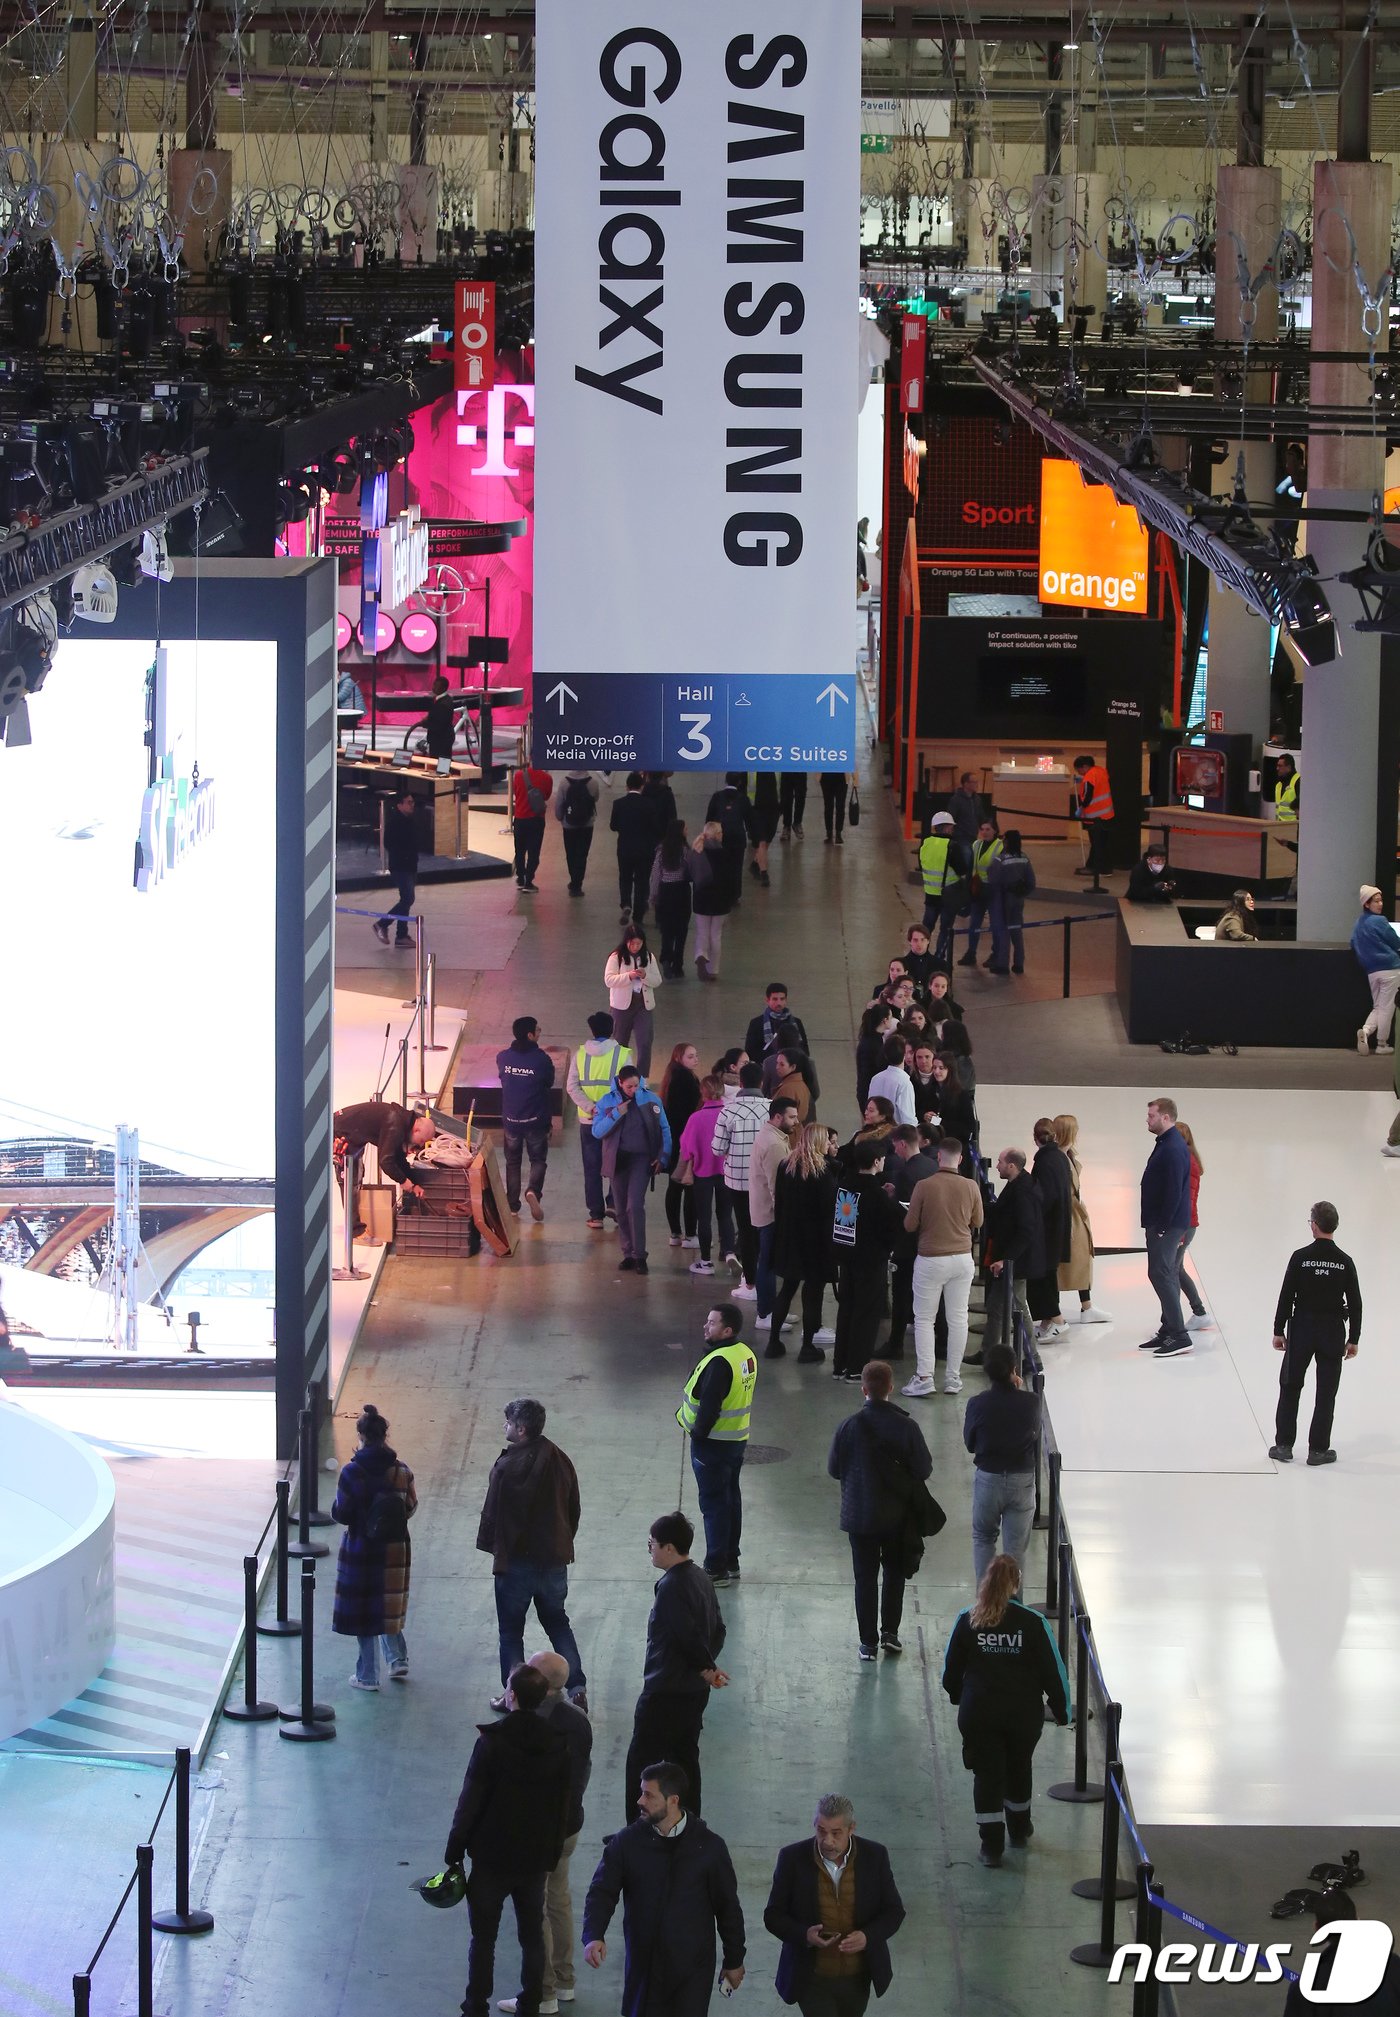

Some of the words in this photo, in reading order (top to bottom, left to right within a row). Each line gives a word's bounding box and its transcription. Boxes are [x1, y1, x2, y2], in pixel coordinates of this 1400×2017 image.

[574, 27, 682, 416] Galaxy
[723, 33, 808, 567] SAMSUNG
[962, 501, 1035, 528] Sport
[334, 545, 360, 554] SAFE
[435, 543, 461, 553] SPOKE
[931, 568, 963, 578] Orange
[964, 568, 977, 577] 5G
[978, 568, 995, 577] Lab
[996, 569, 1015, 577] with
[988, 632, 1000, 640] IoT
[1049, 632, 1078, 642] positive
[988, 641, 1015, 649] impact
[1015, 641, 1045, 649] solution
[678, 685, 713, 701] Hall
[546, 735, 569, 745] VIP
[574, 735, 634, 748] Drop-Off
[677, 713, 712, 761] 3
[546, 749, 586, 760] Media
[590, 749, 637, 762] Village
[744, 746, 783, 762] CC3
[790, 746, 848, 762] Suites
[1301, 1260, 1345, 1270] SEGURIDAD
[977, 1629, 1023, 1647] servi
[1182, 1912, 1205, 1931] SAMSUNG
